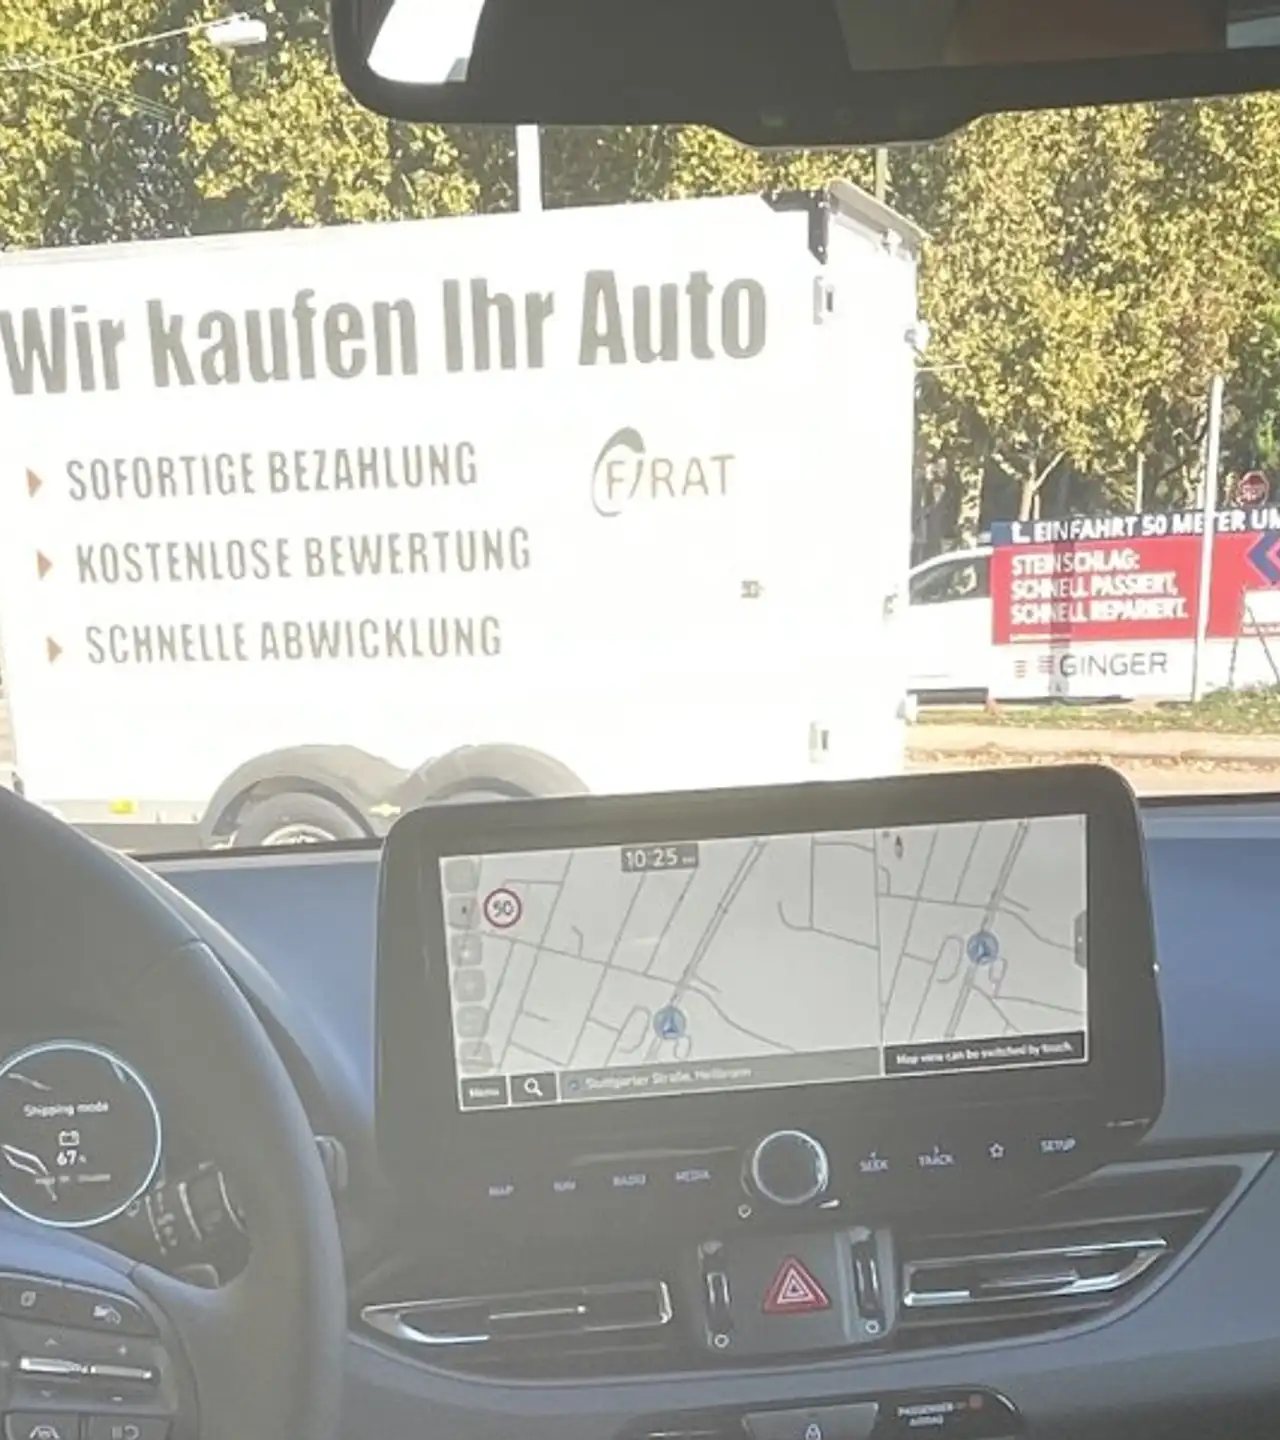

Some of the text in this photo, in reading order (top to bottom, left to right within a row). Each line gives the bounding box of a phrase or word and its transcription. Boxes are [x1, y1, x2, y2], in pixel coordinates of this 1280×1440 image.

[0, 268, 768, 395] Wir kaufen Ihr Auto
[66, 441, 479, 502] SOFORTIGE BEZAHLUNG
[1034, 515, 1138, 543] EINFAHRT
[1142, 513, 1168, 536] 50
[76, 527, 532, 585] KOSTENLOSE BEWERTUNG
[86, 616, 503, 665] SCHNELLE ABWICKLUNG
[1060, 652, 1169, 678] GINGER
[625, 847, 678, 867] 10:25
[23, 1100, 109, 1118] Shipping mode
